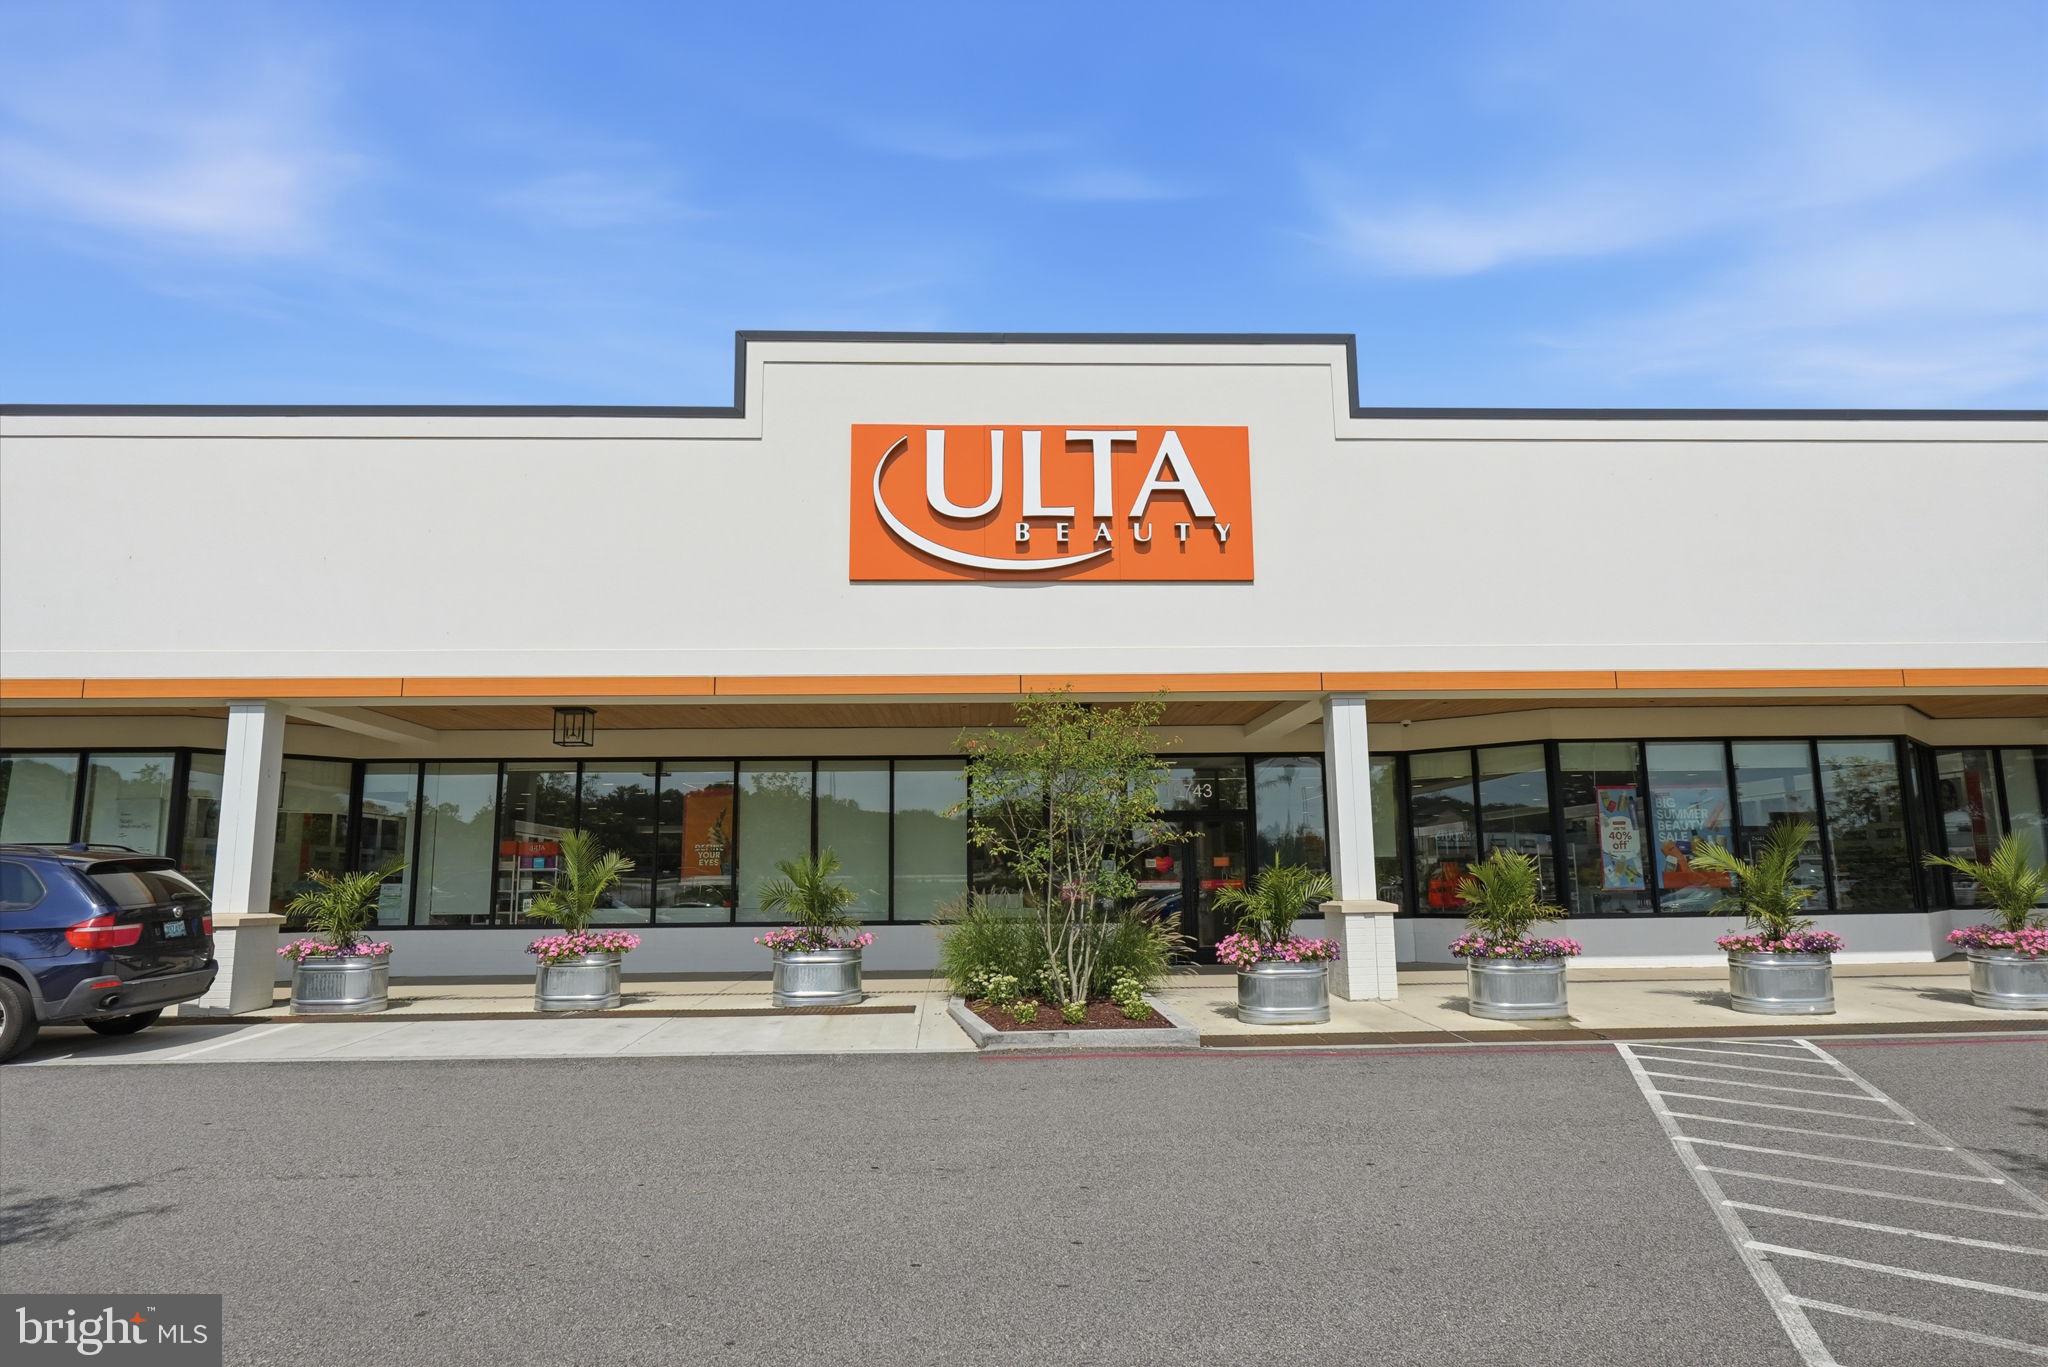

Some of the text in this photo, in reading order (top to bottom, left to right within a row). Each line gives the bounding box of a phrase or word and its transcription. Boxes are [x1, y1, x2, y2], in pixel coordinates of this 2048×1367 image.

[926, 429, 1217, 519] ULTA
[1014, 522, 1231, 543] BEAUTY
[1656, 797, 1676, 808] BIG
[1656, 809, 1708, 819] SUMMER
[1657, 820, 1705, 831] BEAUTY
[1609, 832, 1632, 840] 40%
[1658, 831, 1689, 842] SALE
[697, 851, 721, 859] YOUR
